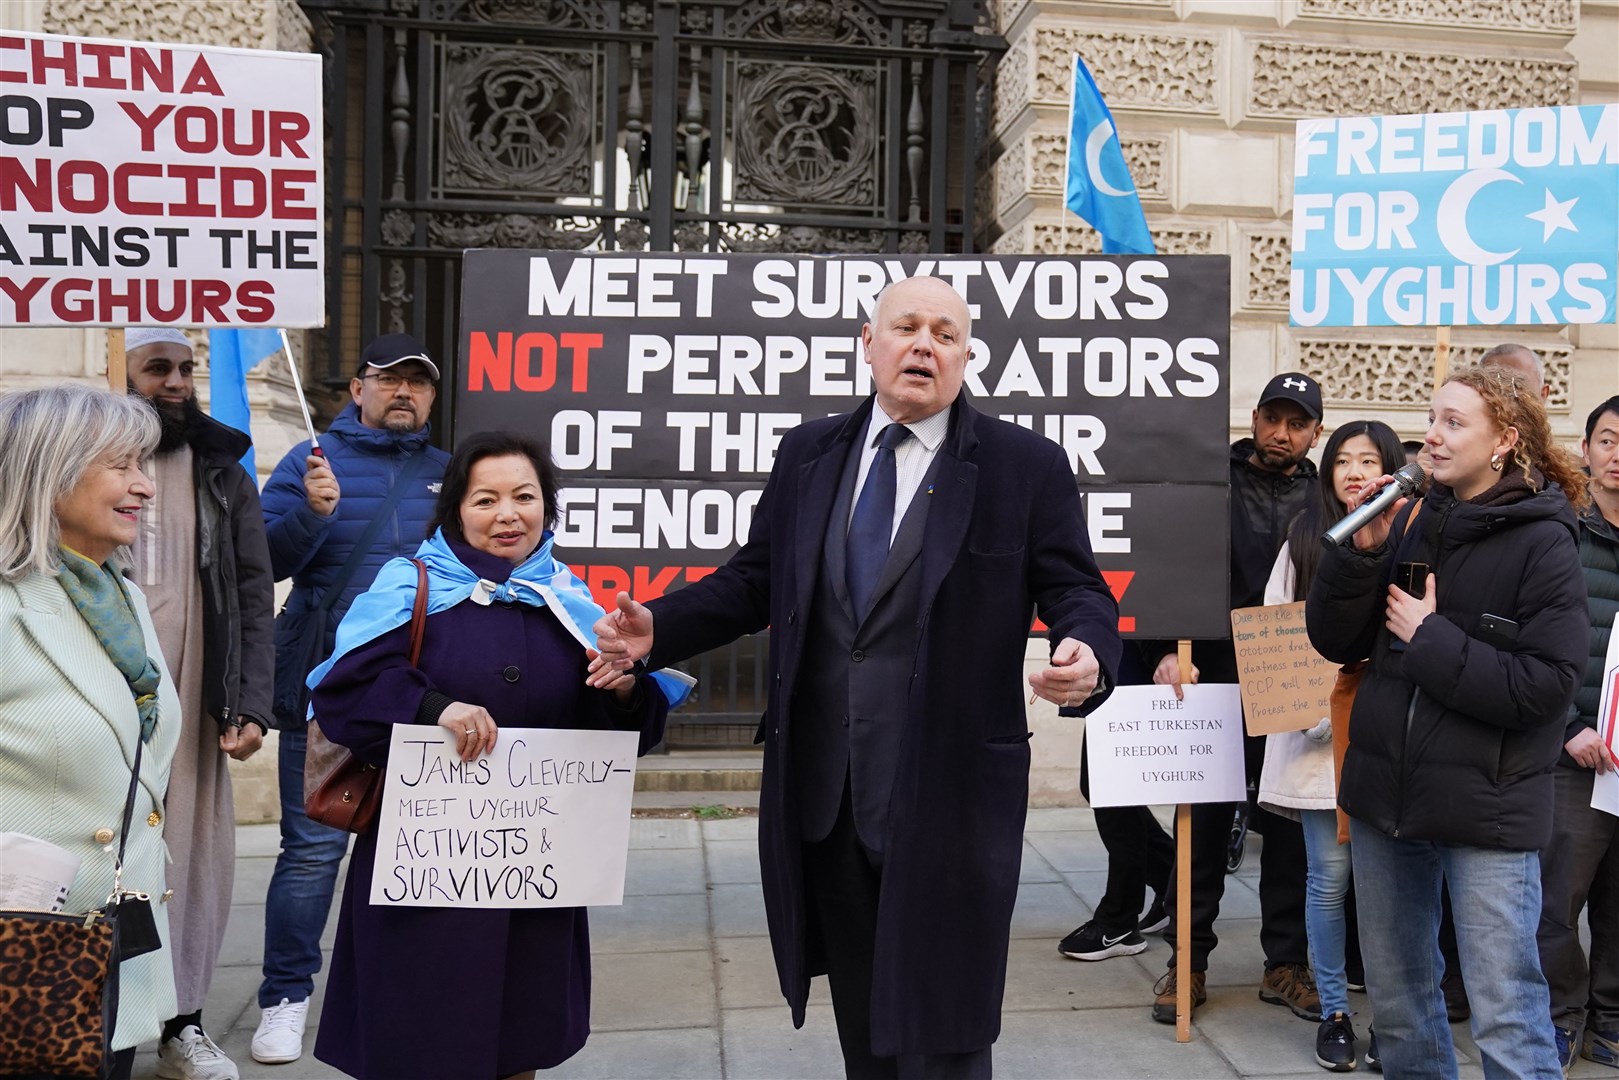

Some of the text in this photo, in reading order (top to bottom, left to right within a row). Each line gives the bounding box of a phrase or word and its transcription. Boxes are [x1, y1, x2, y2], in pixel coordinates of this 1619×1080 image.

[0, 94, 311, 159] OP YOUR
[1294, 103, 1619, 177] FREEDOM
[0, 156, 317, 220] NOCIDE
[1291, 190, 1420, 252] FOR
[0, 223, 318, 270] AINST THE
[0, 277, 275, 323] YGHURS
[527, 257, 724, 318] MEET
[1289, 262, 1608, 327] UYGHURS
[468, 332, 1219, 398] NOT PERPERATORS
[551, 409, 801, 473] OF THE
[1232, 612, 1253, 626] Due
[1258, 612, 1269, 622] to
[1275, 608, 1292, 621] the
[1260, 626, 1269, 638] of
[1243, 657, 1328, 674] deafness and per
[1246, 676, 1274, 696] CCP
[1281, 675, 1300, 690] will
[1308, 676, 1325, 688] not
[1151, 699, 1184, 711] FREE
[1251, 697, 1329, 719] Protest the at
[1108, 719, 1223, 733] EAST TURKESTAN
[400, 741, 491, 787] JAMES
[1114, 744, 1213, 757] FREEDOM FOR
[1141, 770, 1205, 783] UYGHURS
[399, 795, 559, 821] MEET UYGHUR
[395, 827, 552, 861] ACTIVISTS &
[384, 864, 558, 902] SURVIVORS
